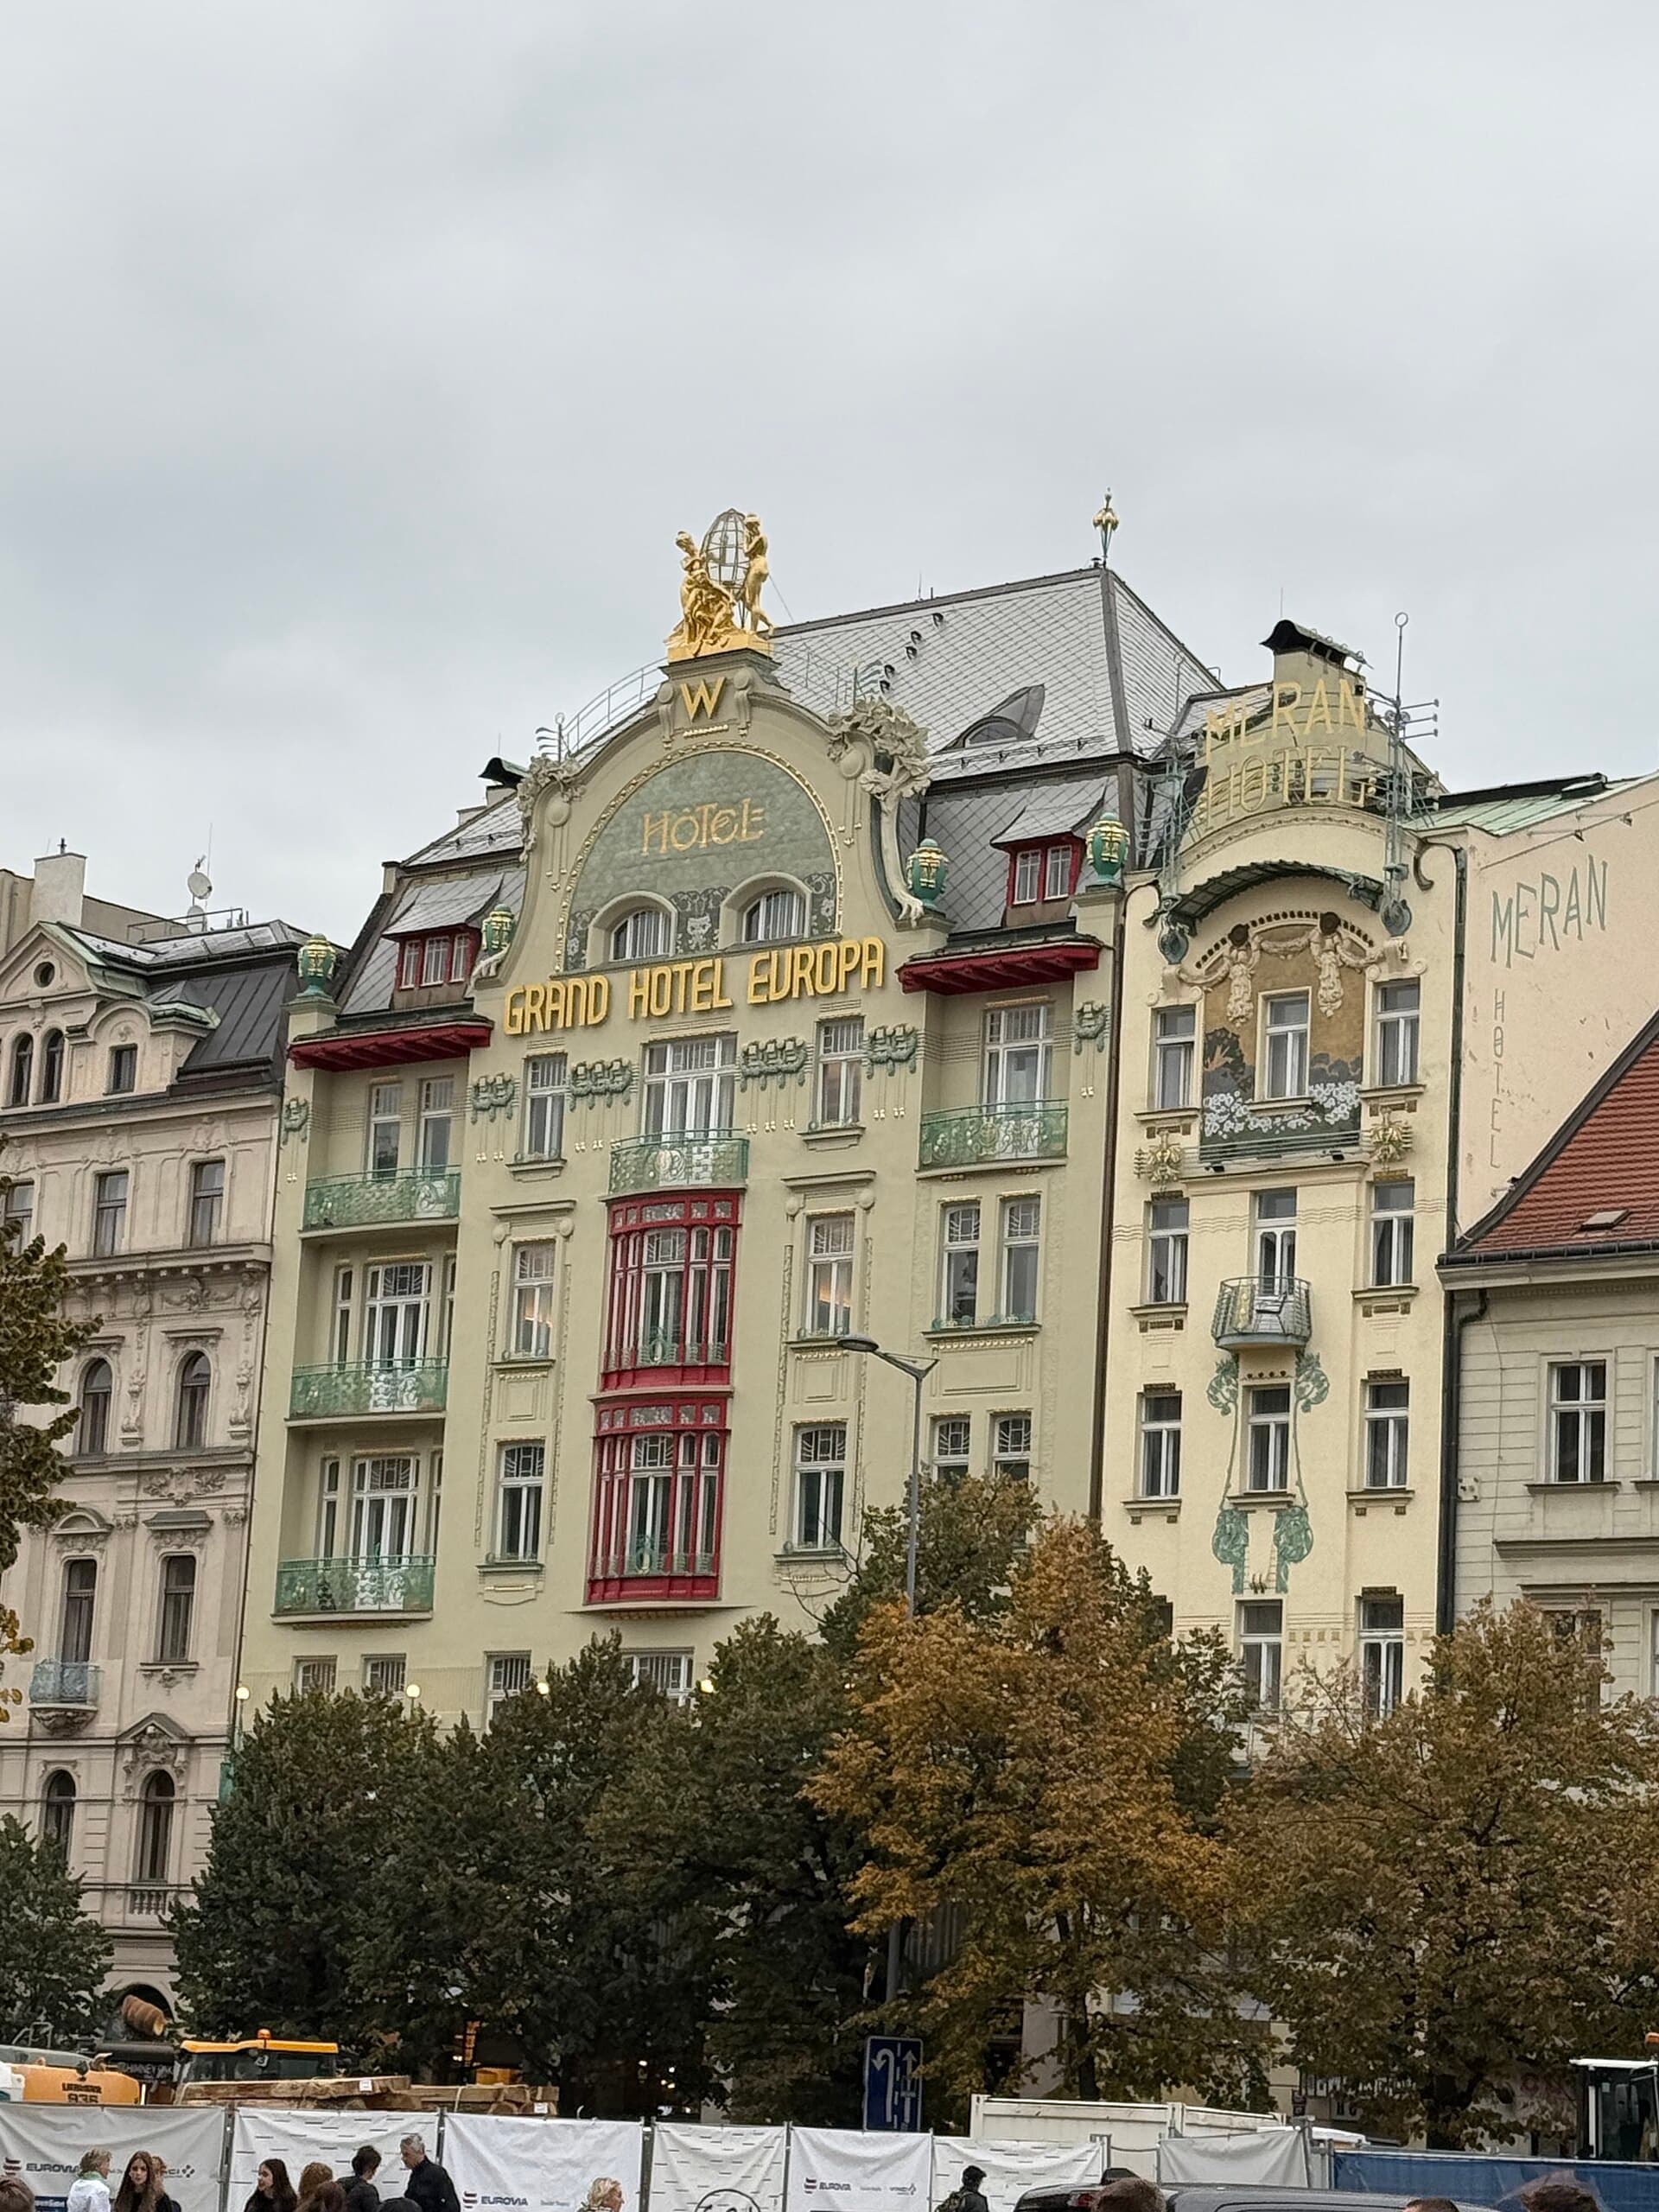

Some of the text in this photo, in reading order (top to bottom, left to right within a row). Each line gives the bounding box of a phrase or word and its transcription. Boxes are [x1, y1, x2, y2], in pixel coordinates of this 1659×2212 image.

[680, 677, 727, 724] W
[1205, 677, 1366, 761] MERAN
[1205, 744, 1365, 829] HOTEL
[1491, 854, 1609, 969] MERAN
[504, 937, 885, 1036] GRAND HOTEL EUROPA
[1490, 988, 1506, 1169] HOTEL
[481, 2196, 528, 2206] EUROVIA
